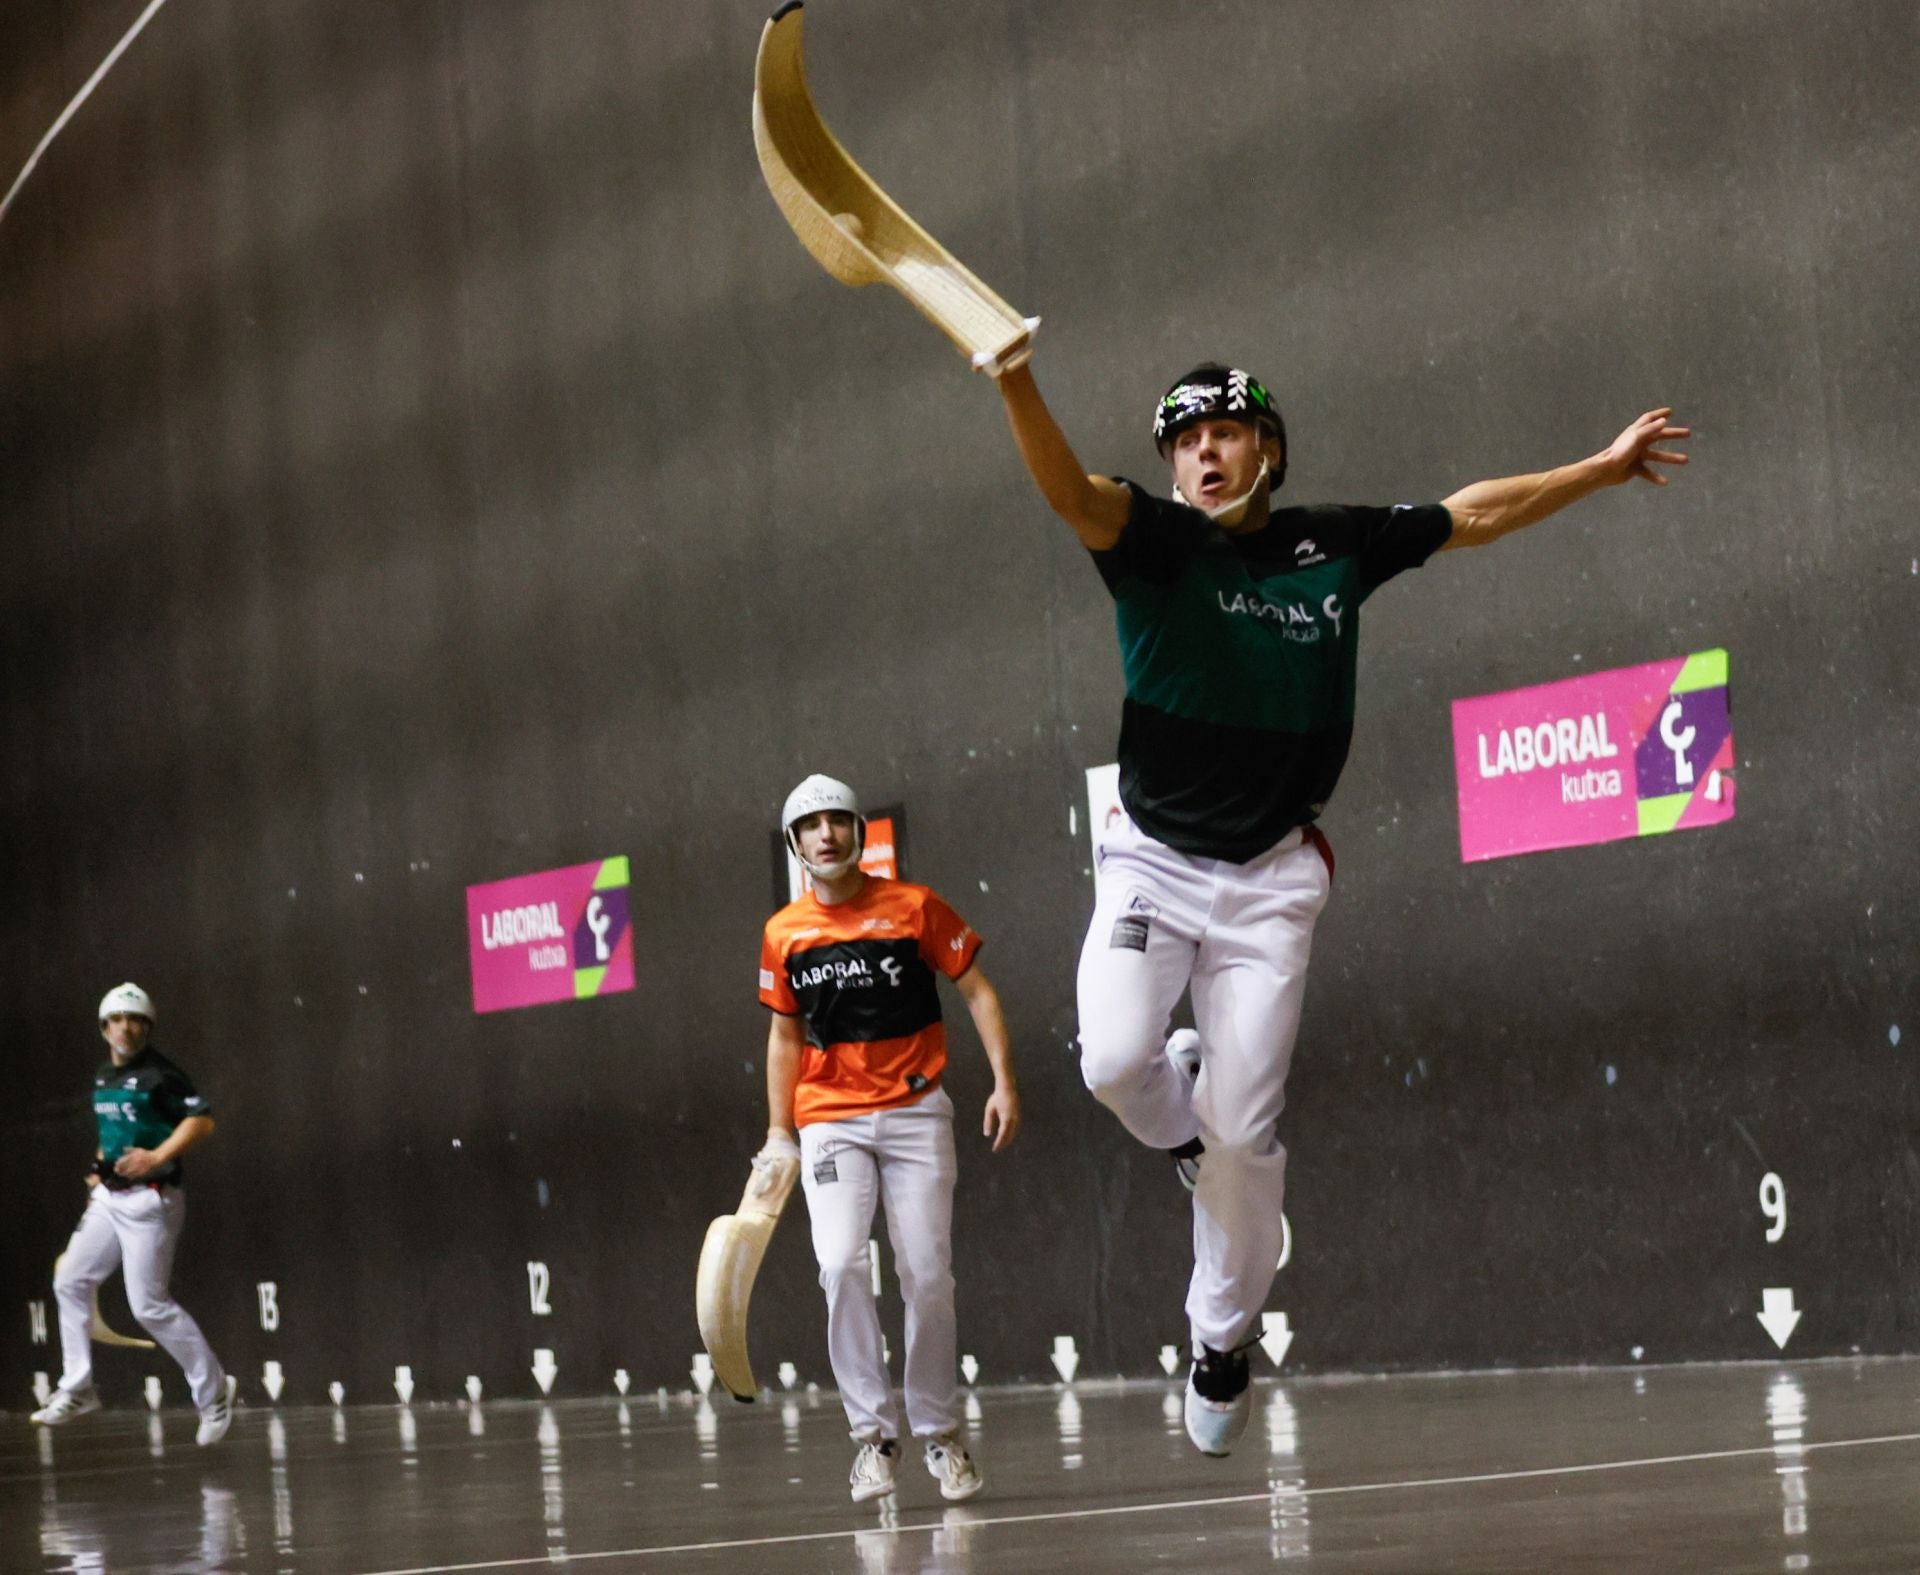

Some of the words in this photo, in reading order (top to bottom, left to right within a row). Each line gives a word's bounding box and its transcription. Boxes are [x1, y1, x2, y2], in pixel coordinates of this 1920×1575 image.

[1478, 712, 1618, 778] LABORAL
[1561, 769, 1622, 804] kutxa
[481, 901, 565, 950] LABORAL
[791, 958, 872, 990] LABORAL
[1759, 1171, 1787, 1243] 9
[257, 1282, 279, 1332] 13
[527, 1261, 552, 1315] 12
